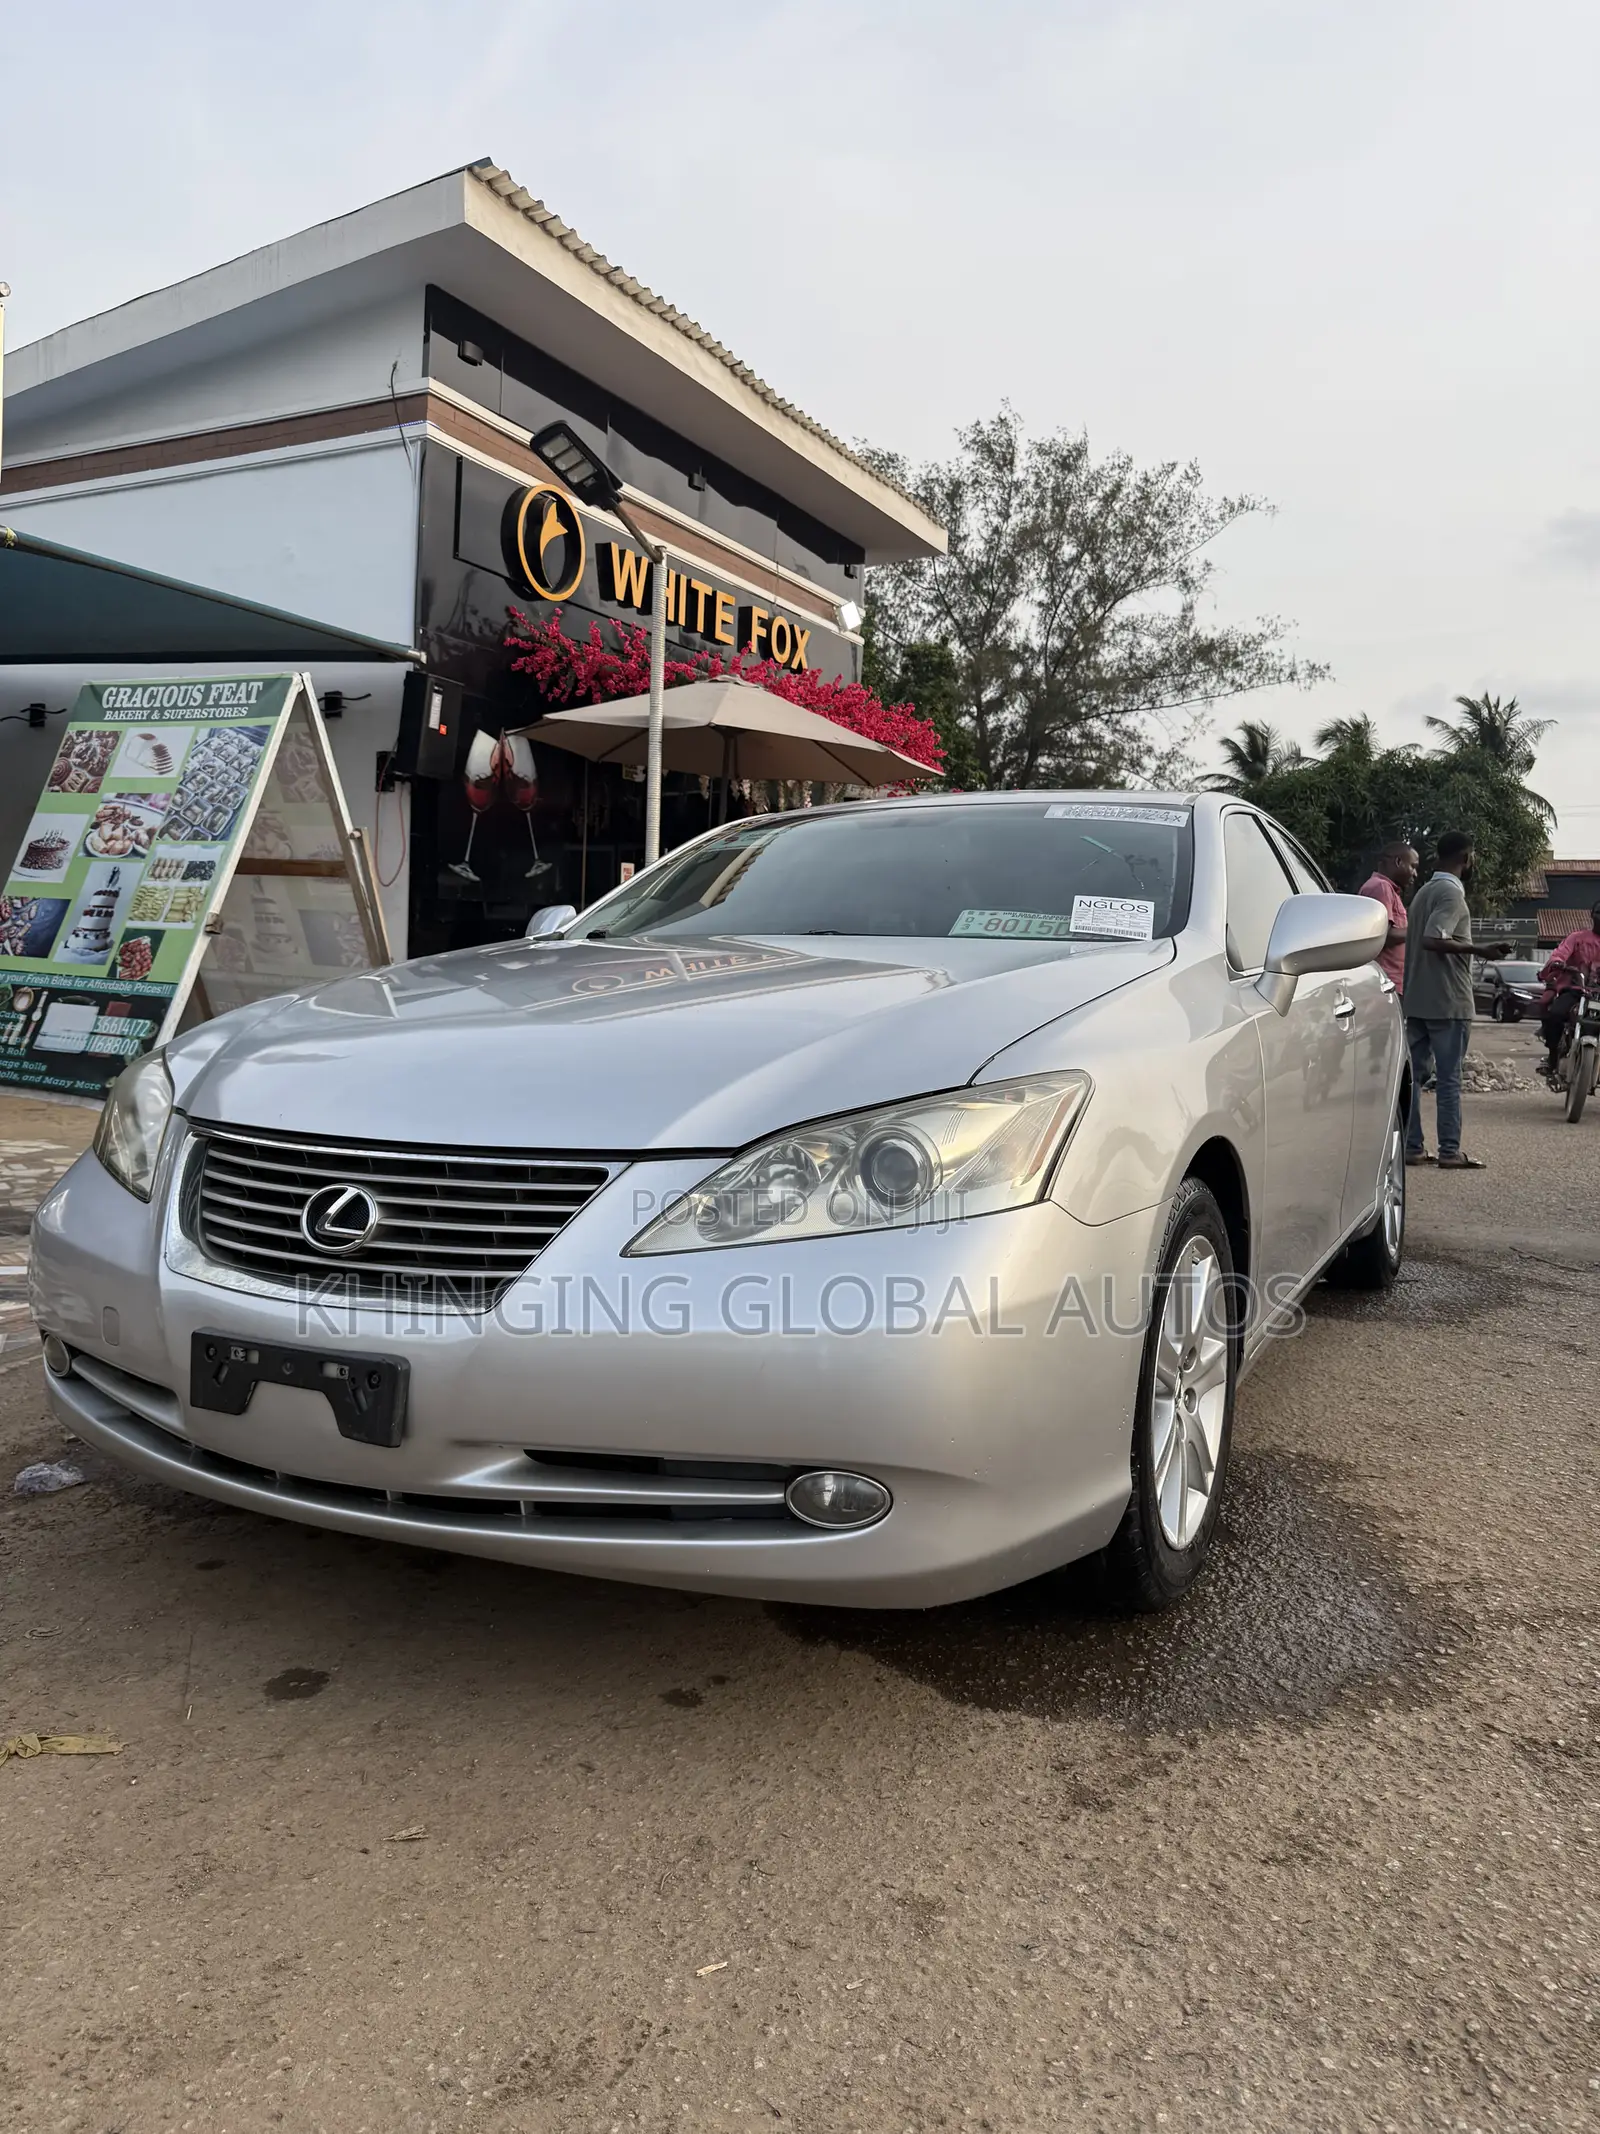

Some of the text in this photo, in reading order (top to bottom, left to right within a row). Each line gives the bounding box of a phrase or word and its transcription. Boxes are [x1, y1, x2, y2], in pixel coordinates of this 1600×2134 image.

[751, 606, 811, 670] FOX
[102, 682, 263, 708] GRACIOUS FEAT
[104, 707, 249, 721] BAKERY & SUPERSTORES
[1079, 899, 1149, 914] NGLOS
[6, 974, 26, 983] your
[26, 974, 50, 984] Fresh
[51, 975, 72, 986] Bites
[74, 978, 87, 988] for
[87, 979, 132, 992] Affordable
[133, 982, 173, 995] Prices!!!
[22, 1061, 48, 1072] Rolls
[22, 1075, 41, 1083] and
[42, 1076, 74, 1089] Many
[74, 1080, 102, 1091] More
